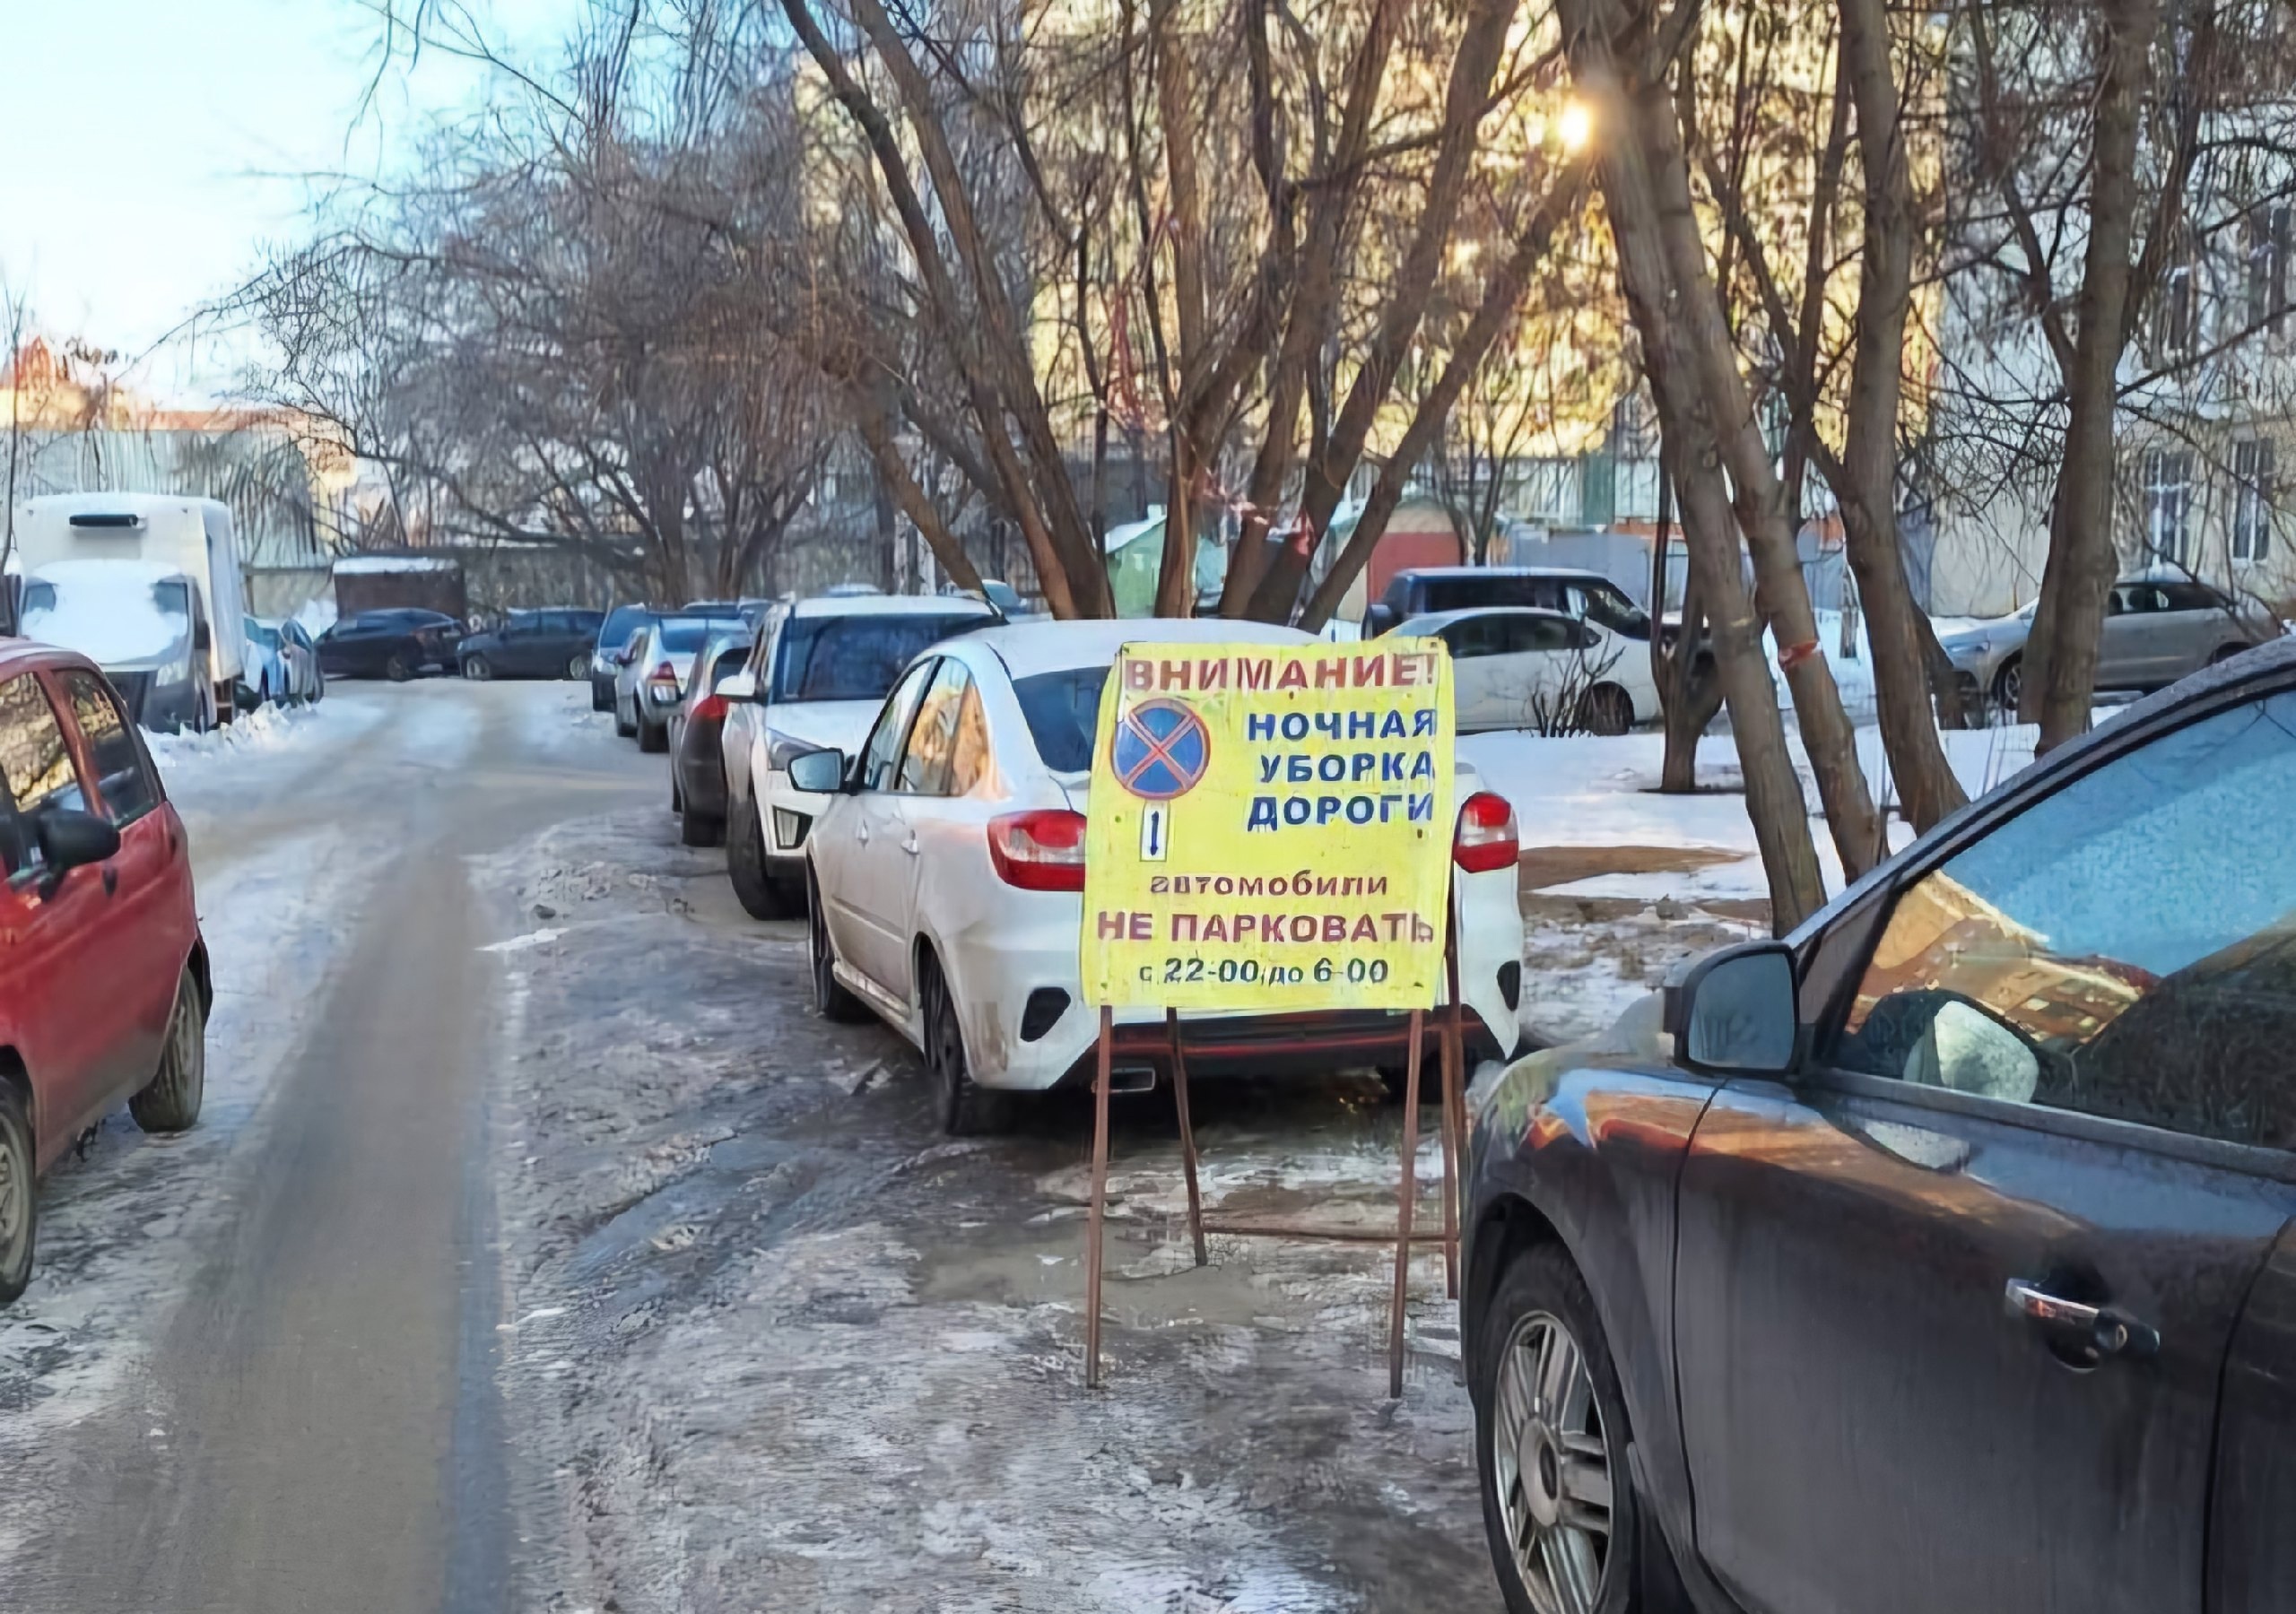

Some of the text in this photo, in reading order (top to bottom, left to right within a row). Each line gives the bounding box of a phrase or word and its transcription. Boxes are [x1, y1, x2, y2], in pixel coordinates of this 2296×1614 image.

[1125, 653, 1435, 690] ВНИМАНИЕ!
[1248, 708, 1436, 741] НОЧНАЯ
[1260, 751, 1434, 783] УБОРКА
[1247, 793, 1433, 832] ДОРОГИ
[1150, 870, 1388, 896] автомобили
[1097, 911, 1434, 942] НЕ ПАРКОВАТЬ
[1139, 965, 1152, 982] с
[1164, 958, 1259, 984] 22-00
[1268, 966, 1304, 985] до
